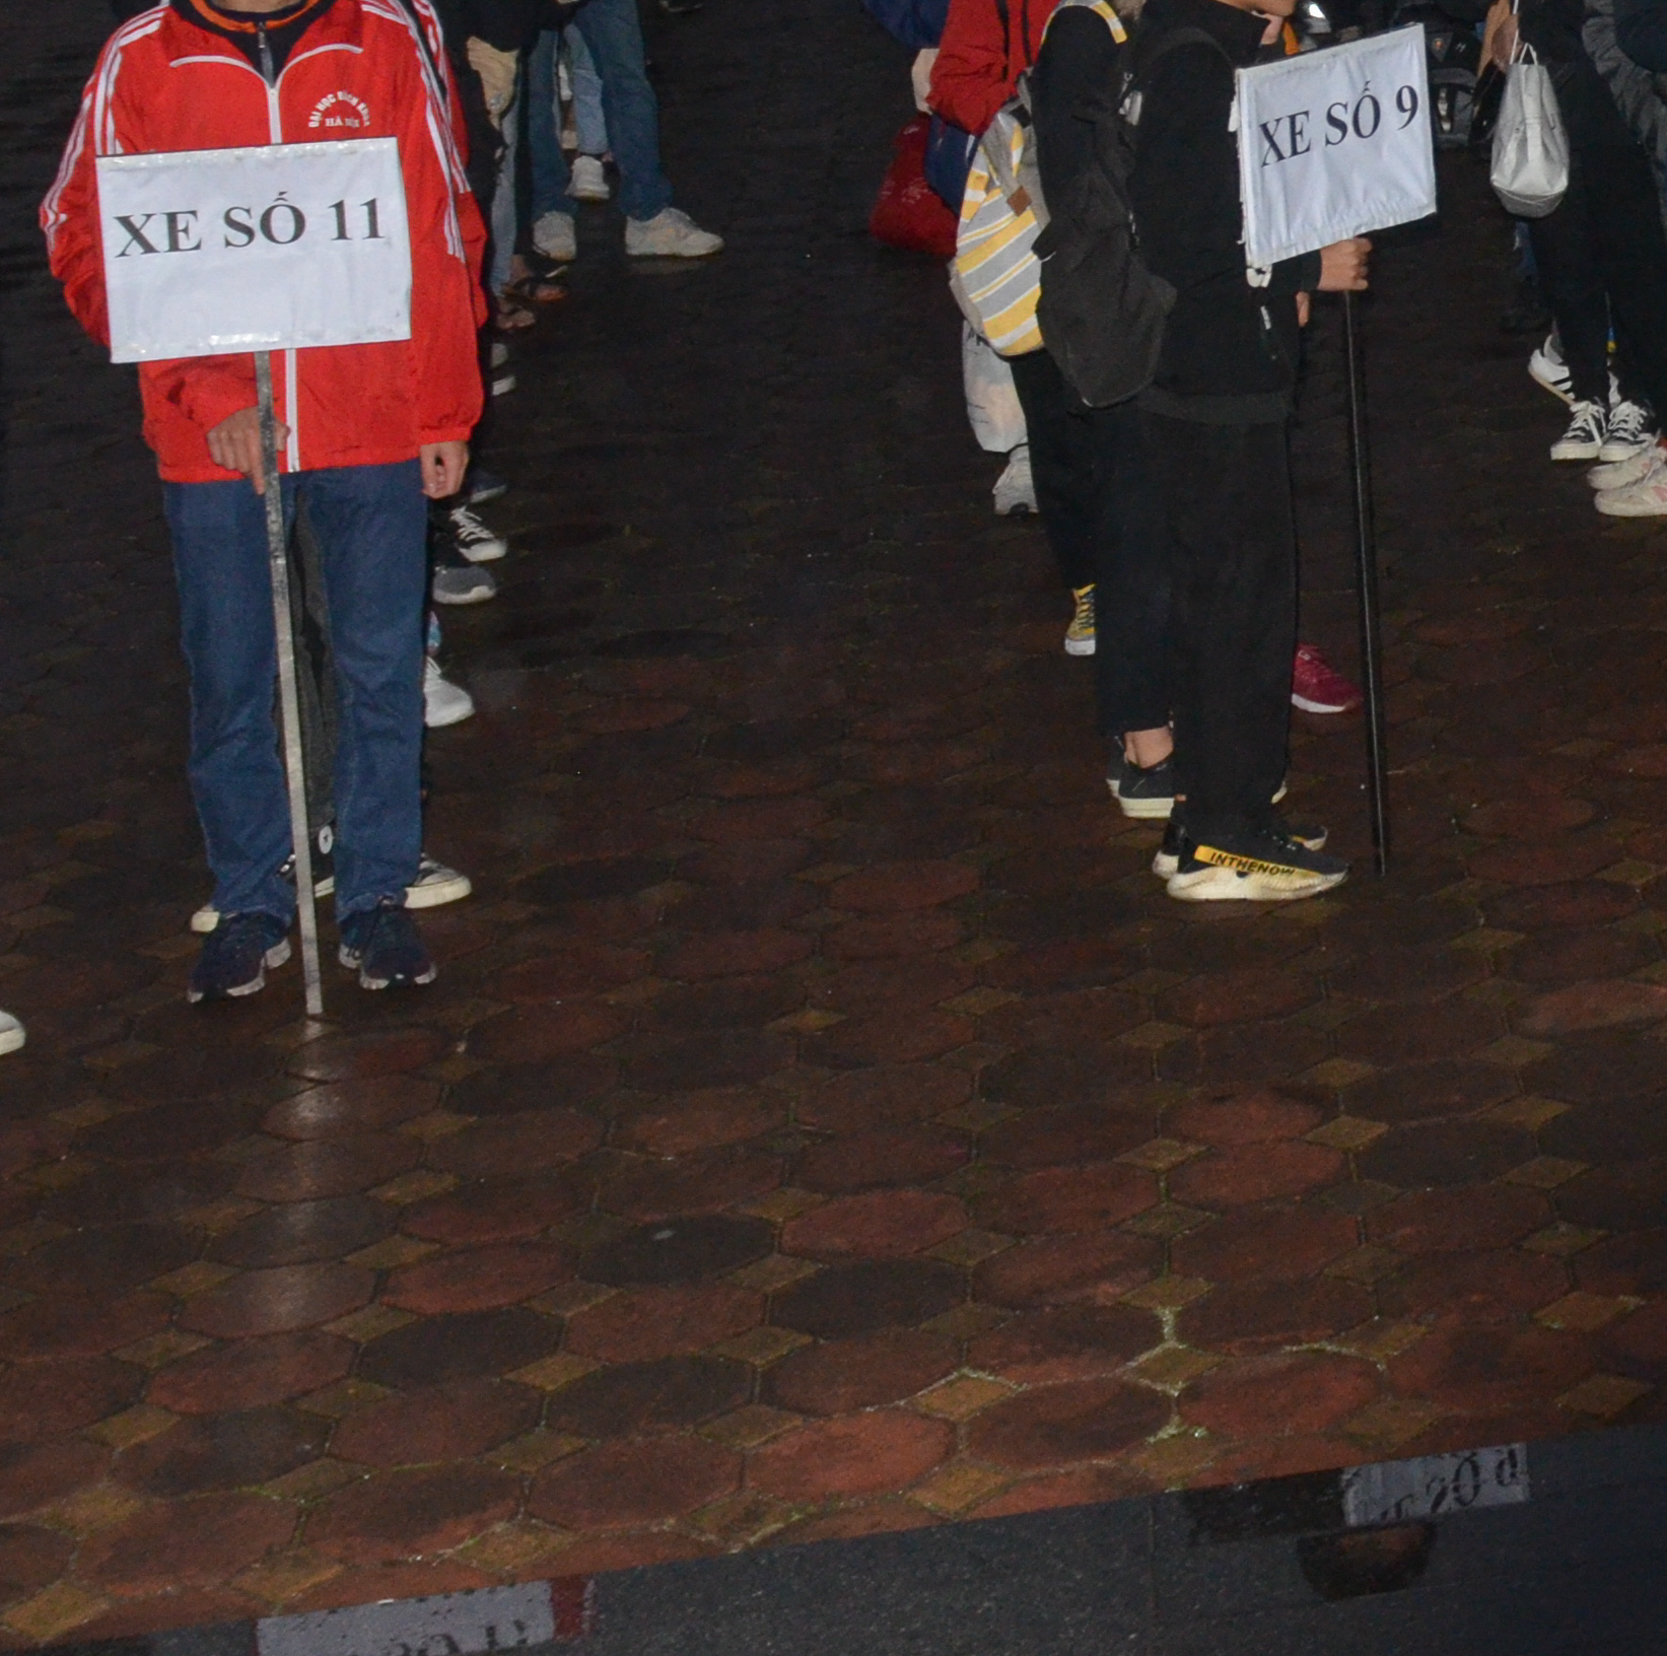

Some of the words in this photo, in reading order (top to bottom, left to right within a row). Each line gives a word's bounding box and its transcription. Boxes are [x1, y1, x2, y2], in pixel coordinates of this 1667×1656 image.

[1258, 110, 1312, 168] XE
[1325, 81, 1381, 147] SỐ
[1395, 85, 1419, 131] 9
[114, 210, 202, 258] XE
[223, 191, 306, 248] SỐ
[328, 198, 384, 241] 11
[1210, 851, 1296, 876] INTHENOW
